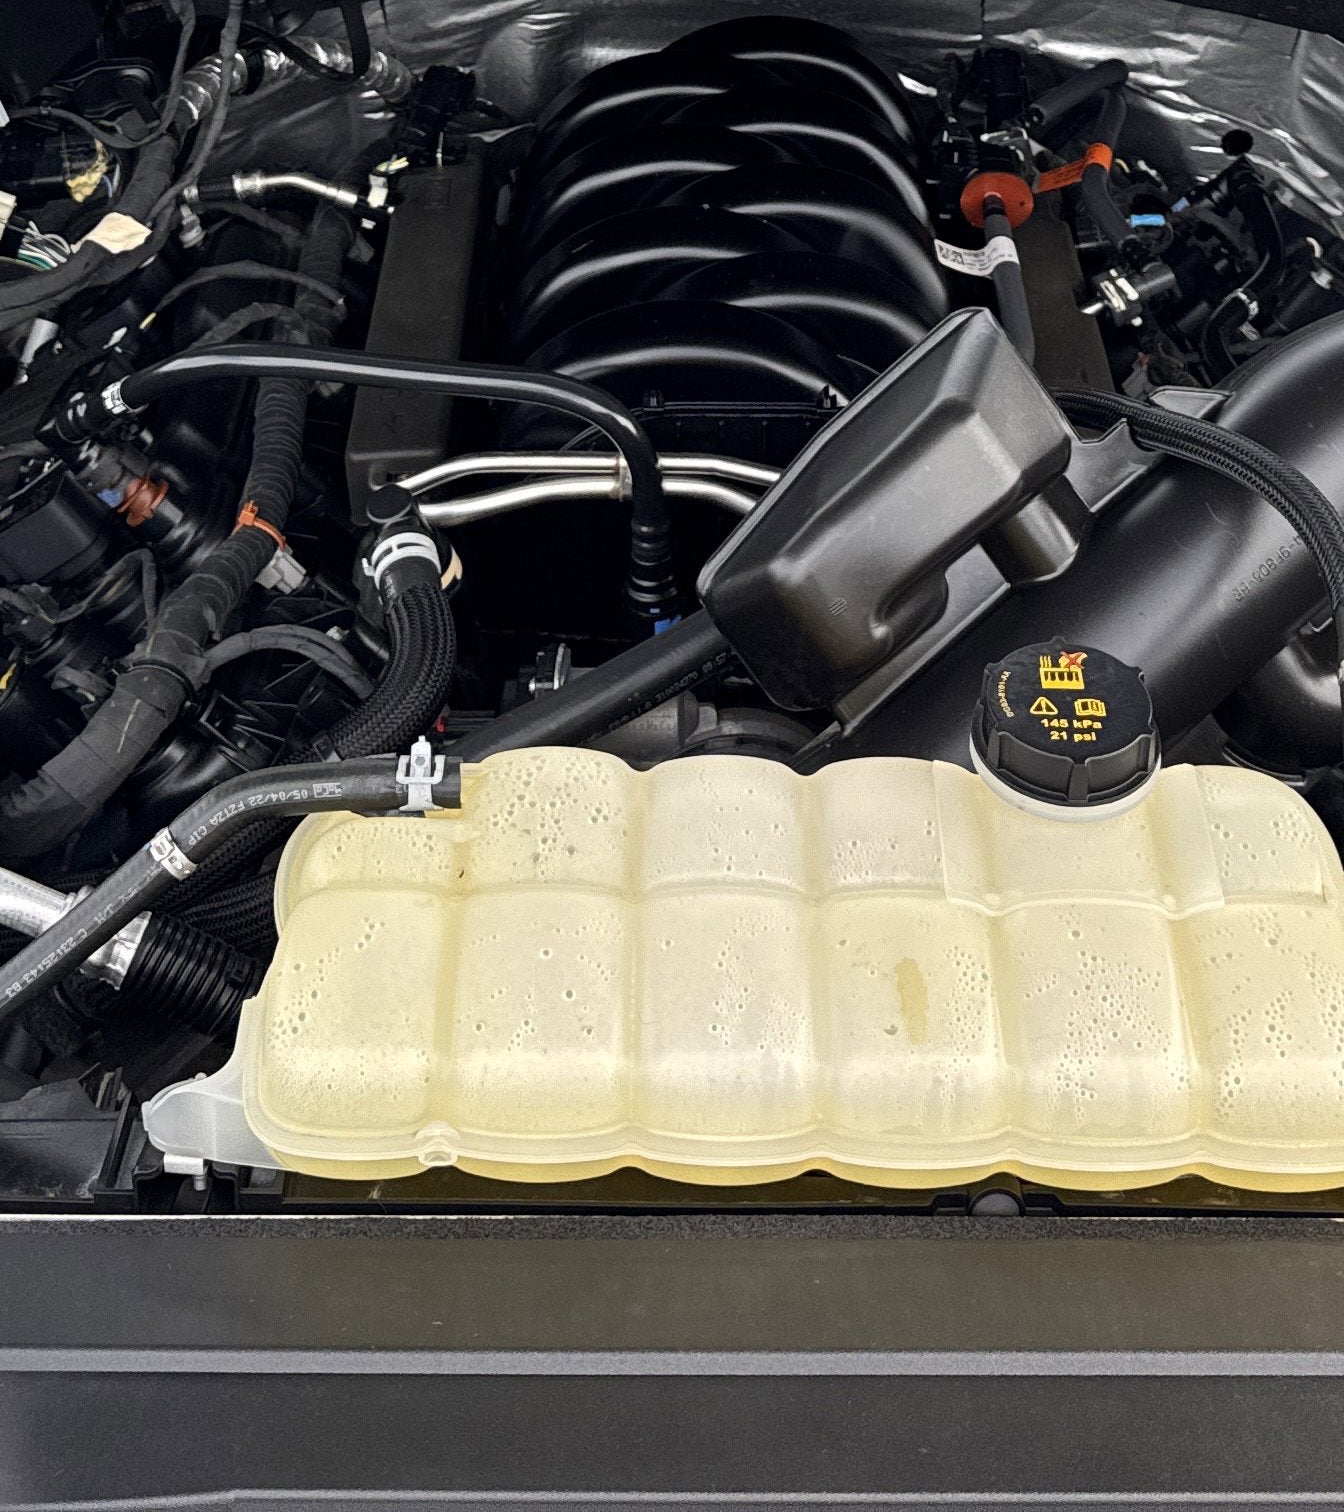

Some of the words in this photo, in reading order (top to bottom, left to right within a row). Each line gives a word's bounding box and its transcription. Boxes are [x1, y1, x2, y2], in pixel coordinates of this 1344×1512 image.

[1040, 719, 1068, 729] 145
[1073, 719, 1102, 729] kPa
[1050, 731, 1067, 741] 21
[1073, 732, 1097, 743] psi
[247, 788, 308, 808] 05/04/22
